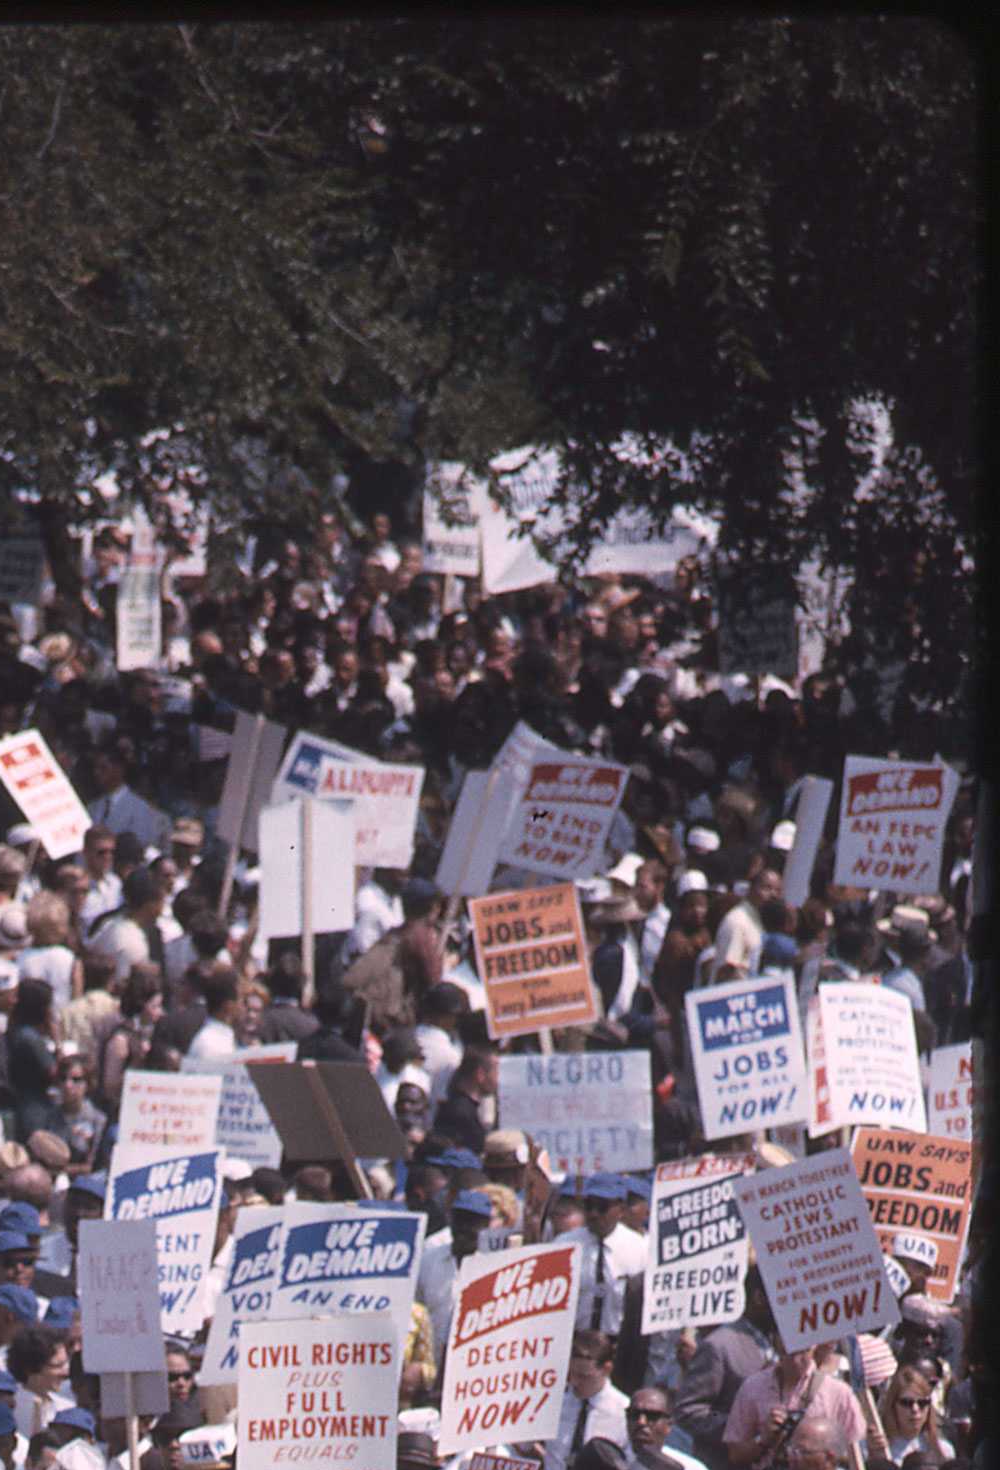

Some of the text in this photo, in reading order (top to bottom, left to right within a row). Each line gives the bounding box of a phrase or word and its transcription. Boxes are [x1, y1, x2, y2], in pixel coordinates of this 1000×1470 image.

[851, 820, 936, 839] AN FEPC
[514, 842, 591, 866] NOW!
[868, 839, 917, 856] LAW
[853, 858, 930, 882] NOW!
[484, 916, 544, 946] JOBS
[485, 943, 578, 978] FREEDOM
[705, 1004, 785, 1038] MARCH
[527, 1055, 623, 1086] NEGRO
[715, 1047, 789, 1080] JOBS
[720, 1088, 796, 1126] NOW!
[848, 1092, 916, 1119] NOW!
[860, 1160, 967, 1199] JOBS and
[759, 1185, 846, 1221] CATHOLIC
[325, 1221, 380, 1249] WE
[783, 1207, 833, 1233] JEWS
[766, 1218, 860, 1256] PROTESTANT
[285, 1243, 410, 1282] DEMAND
[492, 1258, 537, 1298] WE
[652, 1265, 739, 1292] FREEDOM
[290, 1289, 391, 1311] AN END
[460, 1276, 568, 1340] DEMAND
[651, 1289, 734, 1322] MUST LIVE
[798, 1281, 881, 1332] NOW!
[248, 1343, 392, 1369] CIVIL RIGHTS
[467, 1337, 554, 1367] DECENT
[287, 1371, 344, 1387] PLUS
[455, 1369, 557, 1401] HOUSING
[287, 1392, 345, 1414] FULL
[457, 1392, 550, 1435] NOW!
[248, 1416, 390, 1442] EMPLOYMENT
[273, 1443, 359, 1463] EQUALS
